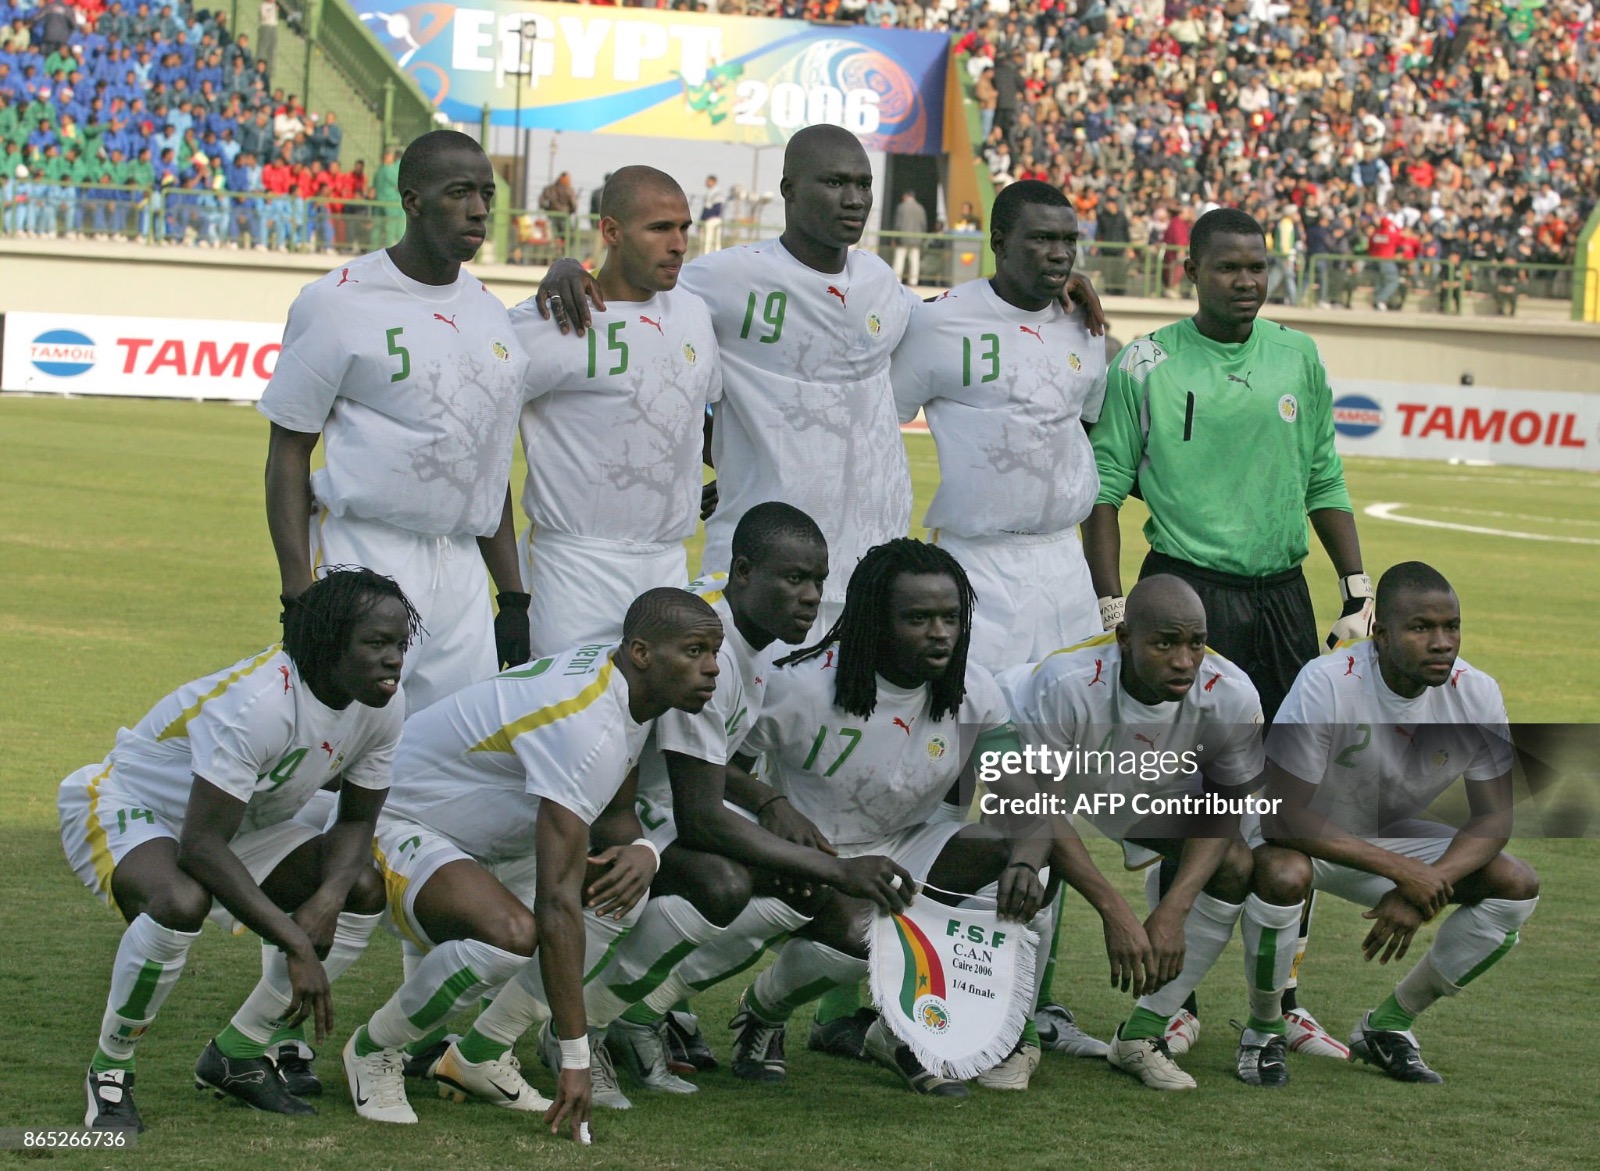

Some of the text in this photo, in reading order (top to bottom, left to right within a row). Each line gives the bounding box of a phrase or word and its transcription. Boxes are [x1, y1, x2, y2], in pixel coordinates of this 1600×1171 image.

[452, 7, 723, 86] EGYPT
[735, 80, 881, 133] 2006
[740, 291, 787, 344] 19
[31, 346, 95, 360] TAMOIL
[116, 338, 282, 380] TAM
[386, 327, 410, 382] 5
[587, 321, 628, 378] 15
[963, 333, 1000, 386] 13
[1183, 391, 1195, 441] 1
[1397, 403, 1587, 448] TAMOIL
[802, 725, 861, 777] 17
[1334, 723, 1371, 768] 2
[117, 808, 154, 834] 14
[947, 919, 1006, 948] F.S.F
[953, 943, 993, 964] C.A.N
[952, 958, 993, 977] Caire 2006
[952, 979, 996, 1000] 1/4 finale
